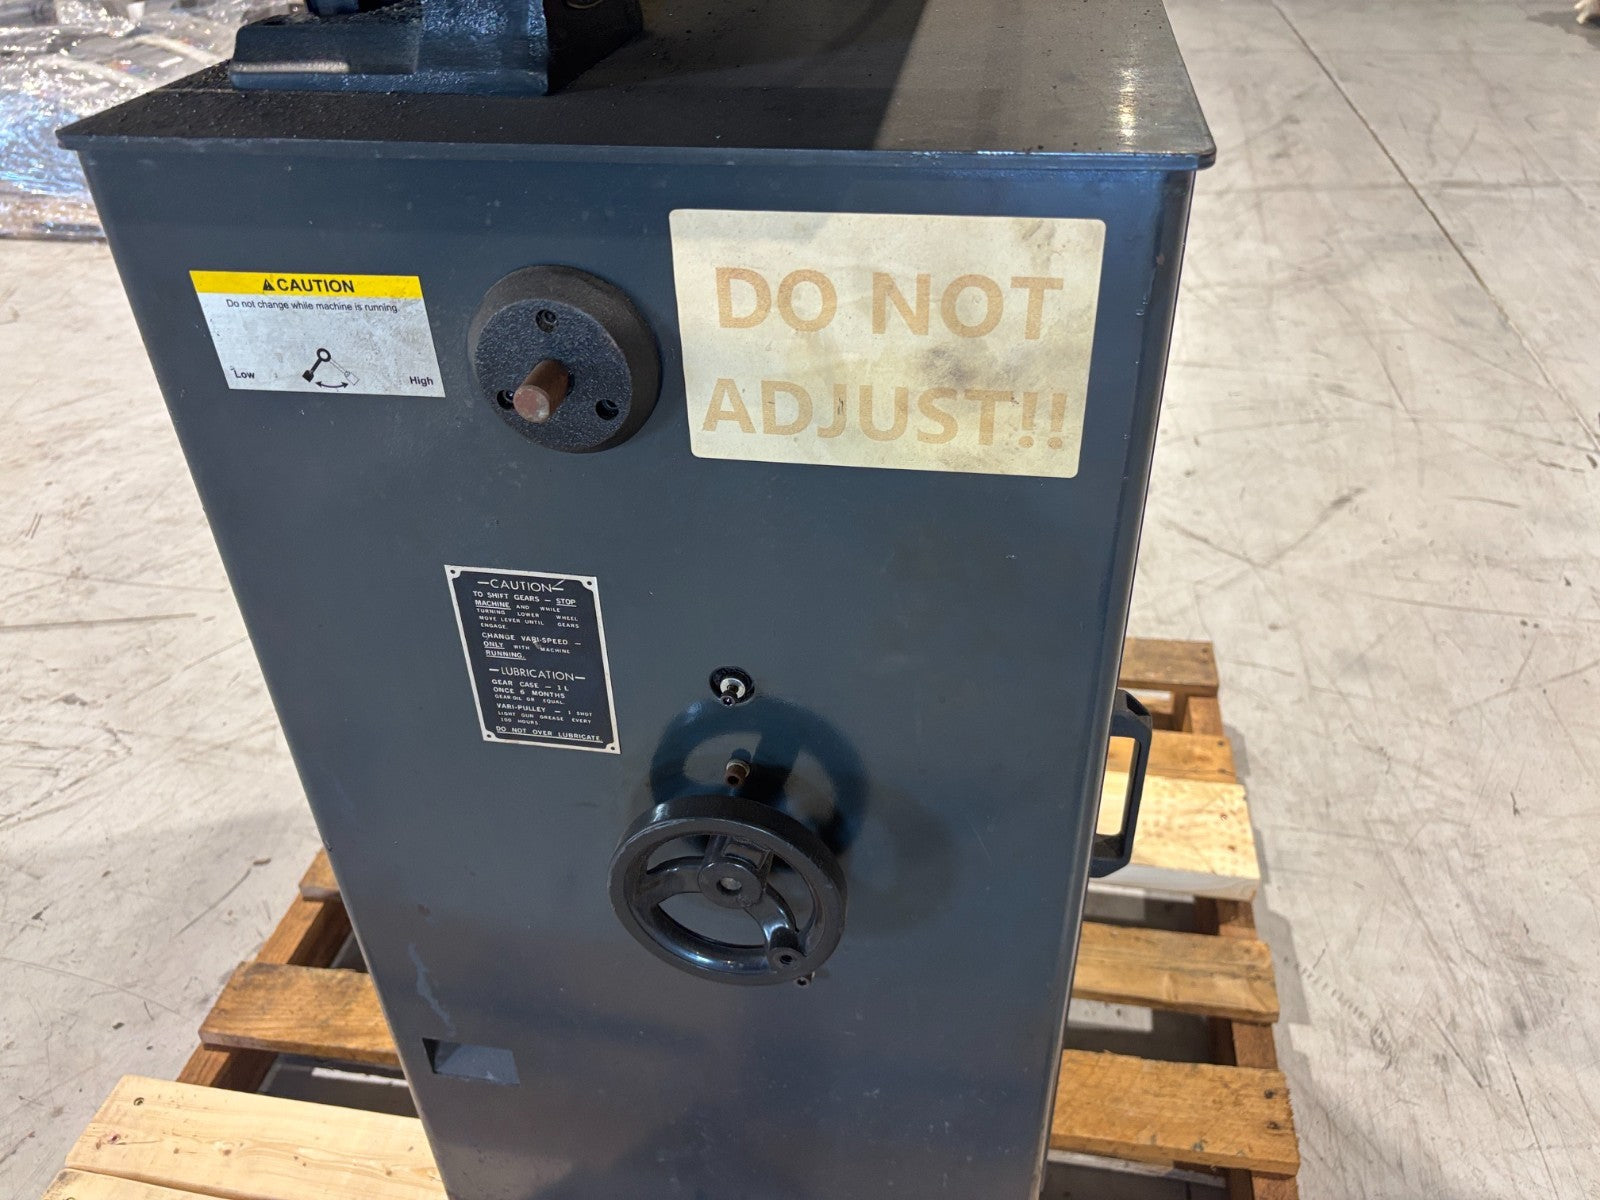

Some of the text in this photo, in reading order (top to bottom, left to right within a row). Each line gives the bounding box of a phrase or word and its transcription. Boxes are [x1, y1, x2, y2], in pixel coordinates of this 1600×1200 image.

[277, 278, 355, 293] CAUTION
[226, 299, 240, 307] Do
[242, 300, 256, 308] not
[258, 300, 289, 310] change
[291, 302, 313, 310] while
[316, 302, 352, 311] machine
[355, 303, 362, 311] is
[714, 266, 1064, 340] DO NOT
[234, 369, 255, 379] Low
[410, 376, 433, 386] High
[701, 377, 1068, 450] ADJUST!!
[490, 579, 552, 592] CAUTION
[482, 632, 515, 640] CHANGE
[501, 667, 574, 681] LUBRICATION
[532, 690, 565, 698] MONTHS
[497, 703, 545, 712] VARI-PULLEY
